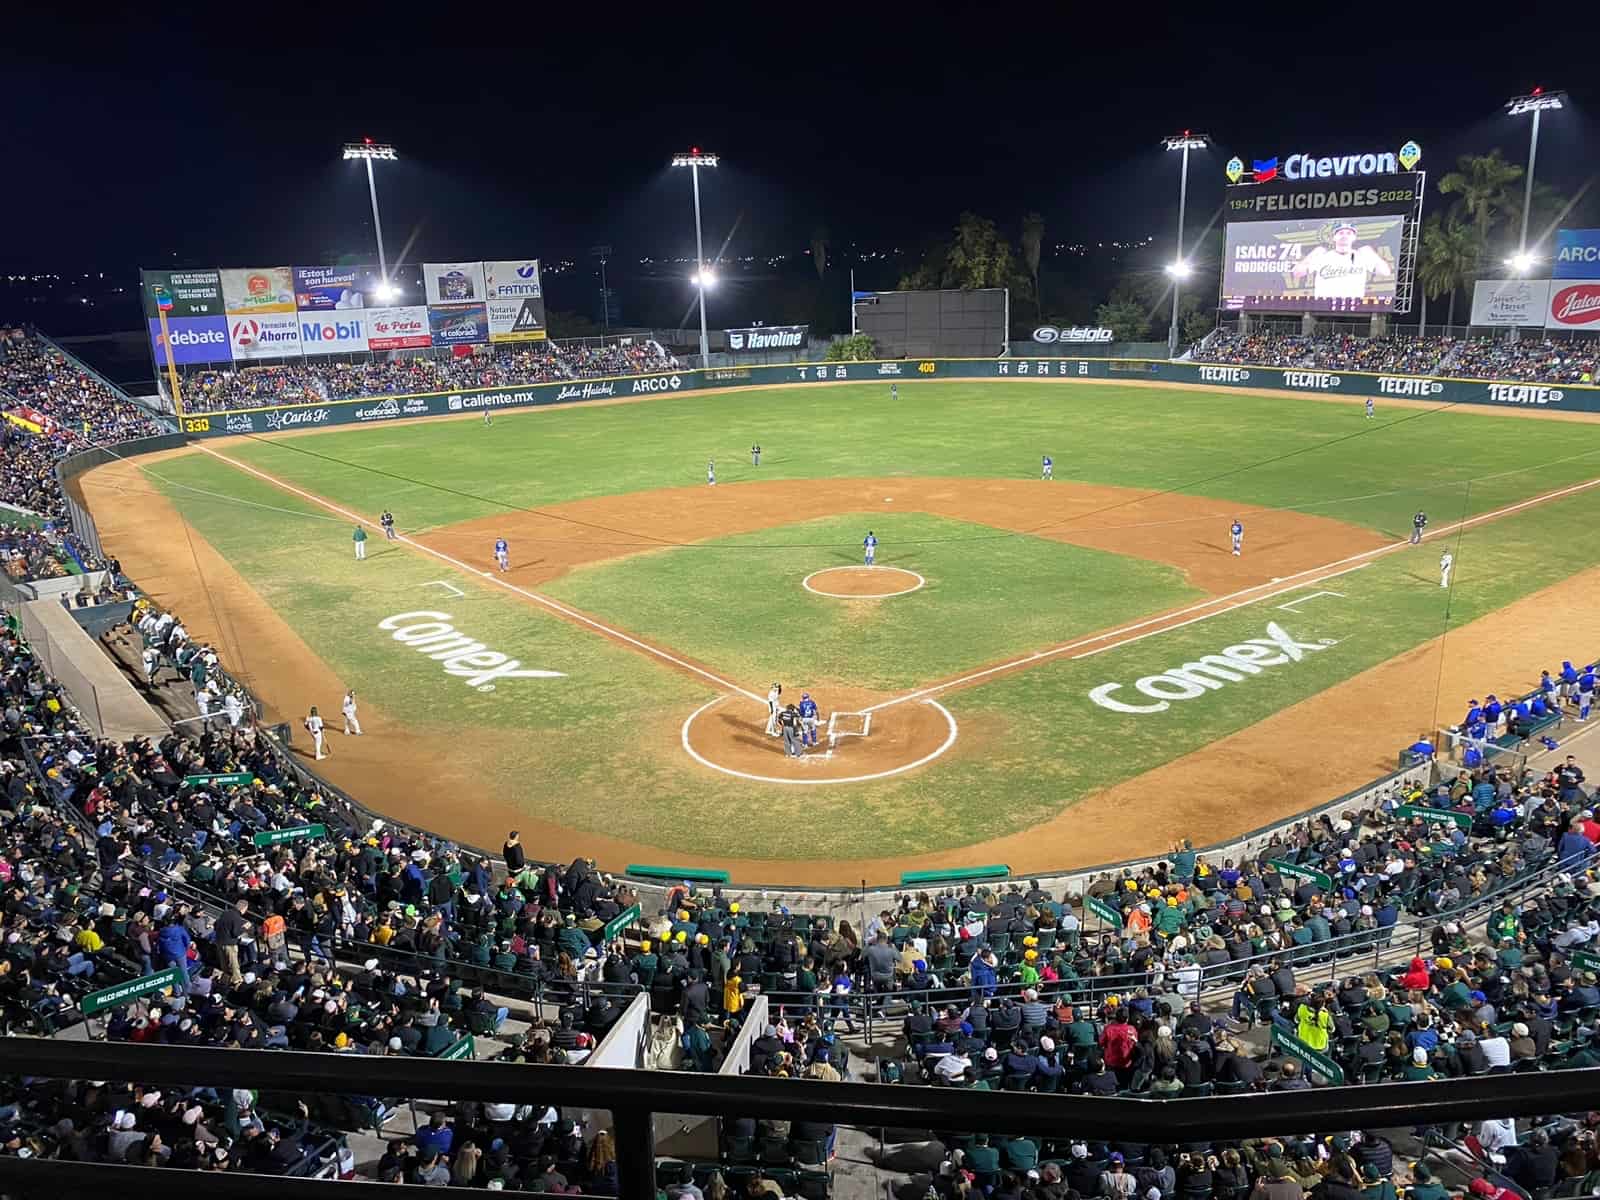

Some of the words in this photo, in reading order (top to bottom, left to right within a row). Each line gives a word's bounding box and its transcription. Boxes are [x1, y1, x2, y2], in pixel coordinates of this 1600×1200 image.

[1284, 152, 1395, 180] Chevron
[1229, 198, 1255, 210] 1947
[1255, 189, 1379, 212] FELICIDADES
[1380, 189, 1413, 202] 2022
[1235, 245, 1277, 259] ISAAC
[1279, 243, 1302, 260] 74
[1558, 247, 1600, 262] ARC
[169, 329, 225, 345] debate
[258, 331, 297, 342] Ahorro
[302, 320, 362, 342] Mobil
[747, 330, 803, 350] Havoline
[918, 362, 936, 374] 400
[1198, 365, 1243, 382] TECATE
[631, 377, 668, 393] ARCO
[1282, 371, 1332, 388] TECATE
[1377, 376, 1434, 396] TECATE
[462, 391, 534, 408] caliente.mx
[1487, 383, 1552, 404] TECATE
[282, 411, 314, 425] Carl's
[355, 408, 364, 418] el
[364, 407, 401, 417] colorado
[186, 418, 210, 433] 330
[378, 610, 569, 687] Comex
[1088, 620, 1328, 714] Comex
